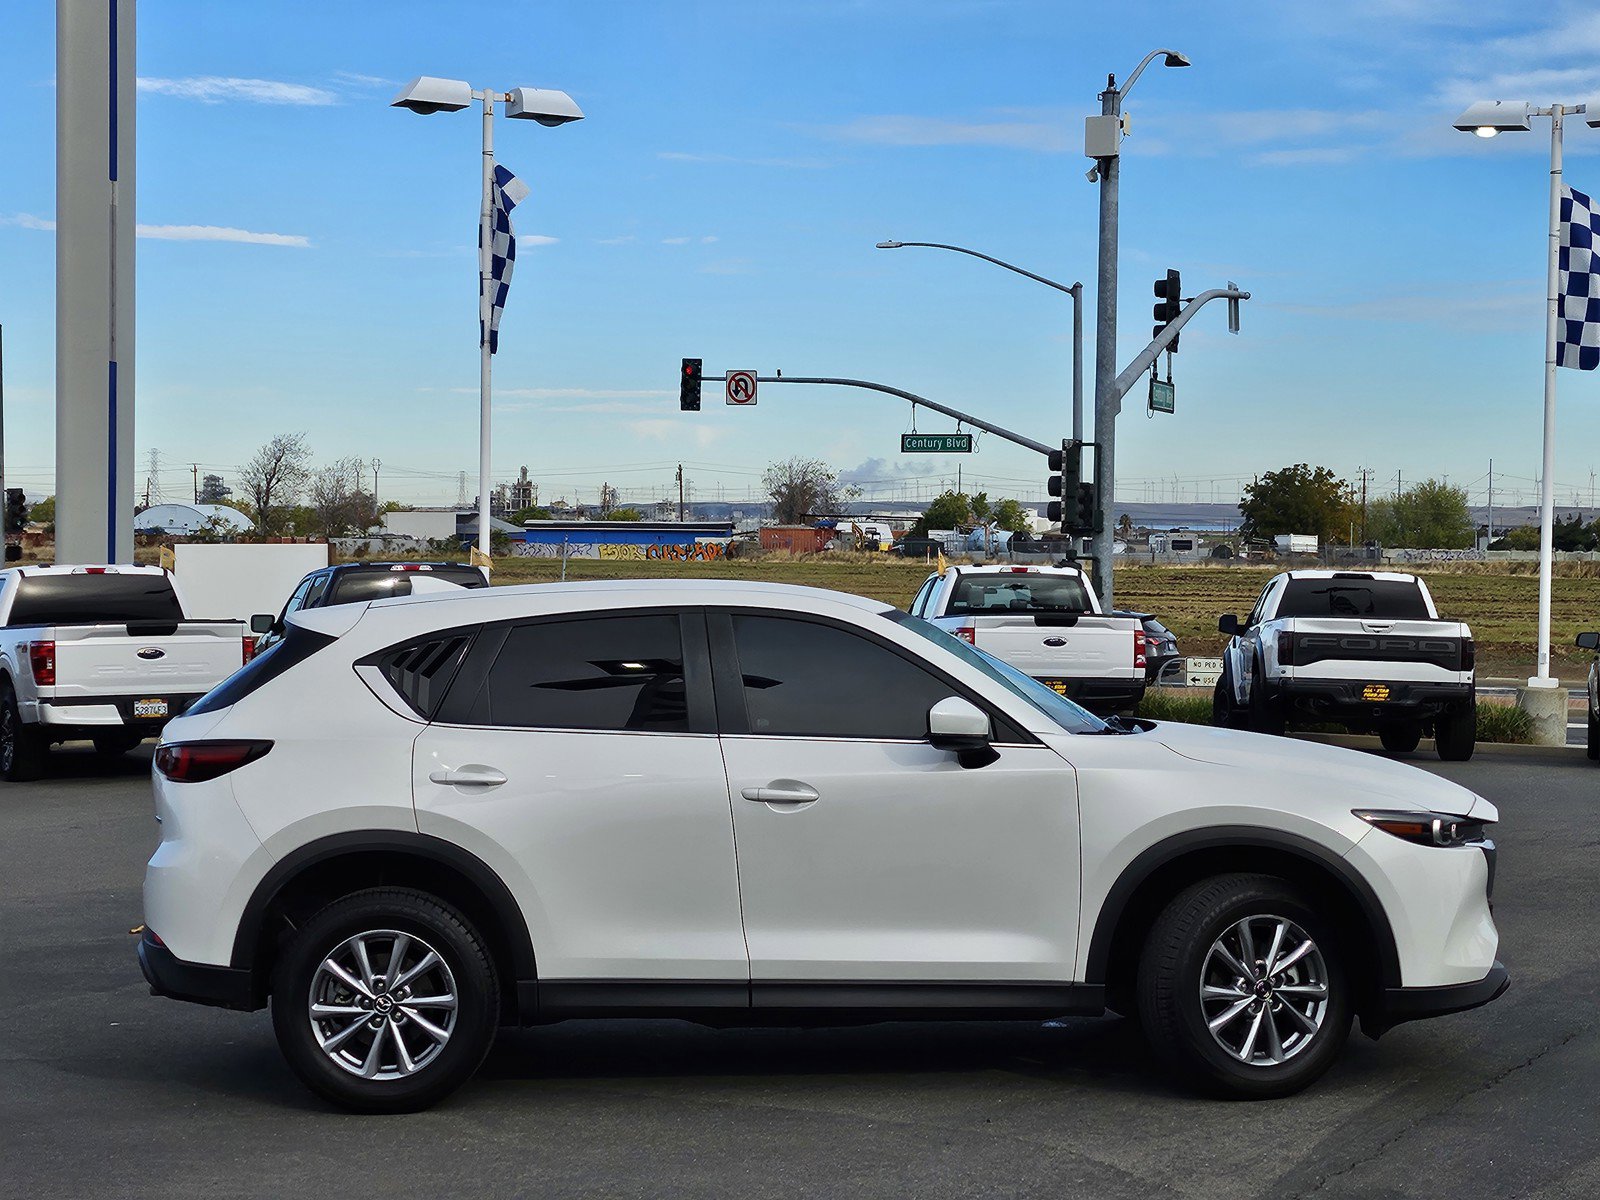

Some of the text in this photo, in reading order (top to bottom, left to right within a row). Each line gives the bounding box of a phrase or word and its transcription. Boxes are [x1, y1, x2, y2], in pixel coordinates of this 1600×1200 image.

[905, 438, 967, 450] Century Blvd
[1301, 637, 1456, 652] FORD
[1204, 661, 1217, 669] PED
